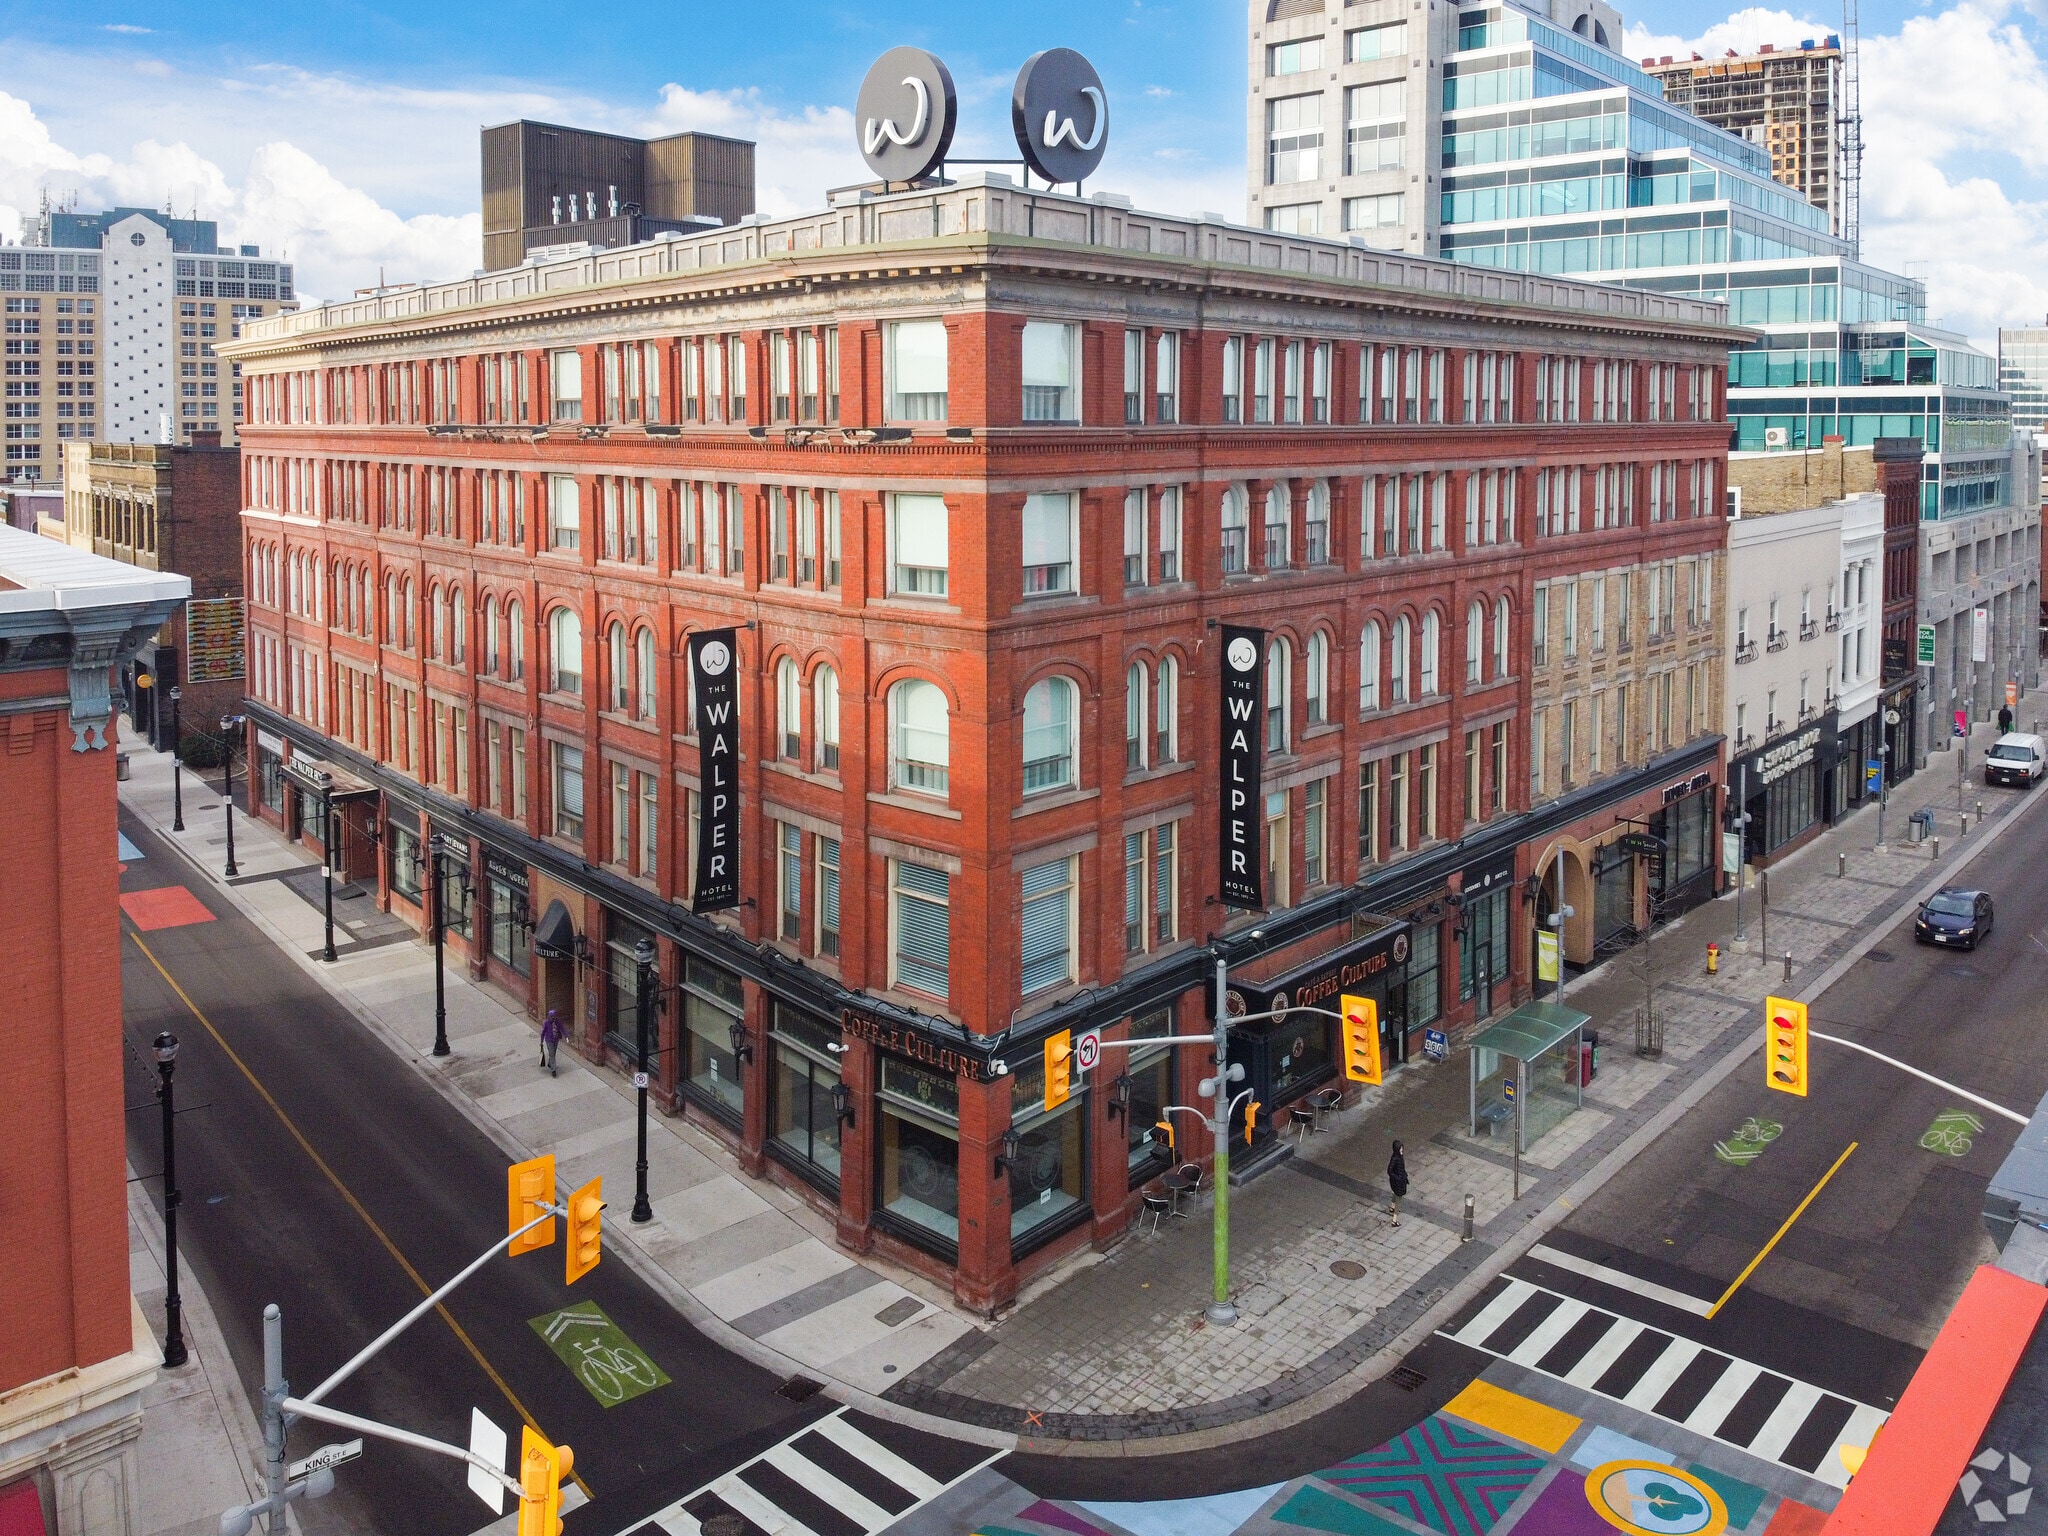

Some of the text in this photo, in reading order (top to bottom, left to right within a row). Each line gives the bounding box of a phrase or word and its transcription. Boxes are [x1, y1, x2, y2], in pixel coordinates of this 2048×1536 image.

[708, 684, 726, 694] THE
[1232, 681, 1251, 690] THE
[705, 701, 731, 879] WALPER
[1228, 697, 1254, 875] WALPER
[452, 837, 468, 854] EVANS
[701, 884, 732, 897] HOTEL
[1225, 881, 1255, 894] HOTEL
[1296, 975, 1339, 1008] COFFEE
[1341, 951, 1388, 987] CULTURE
[905, 1031, 980, 1081] CULTURE
[305, 1455, 331, 1470] KING
